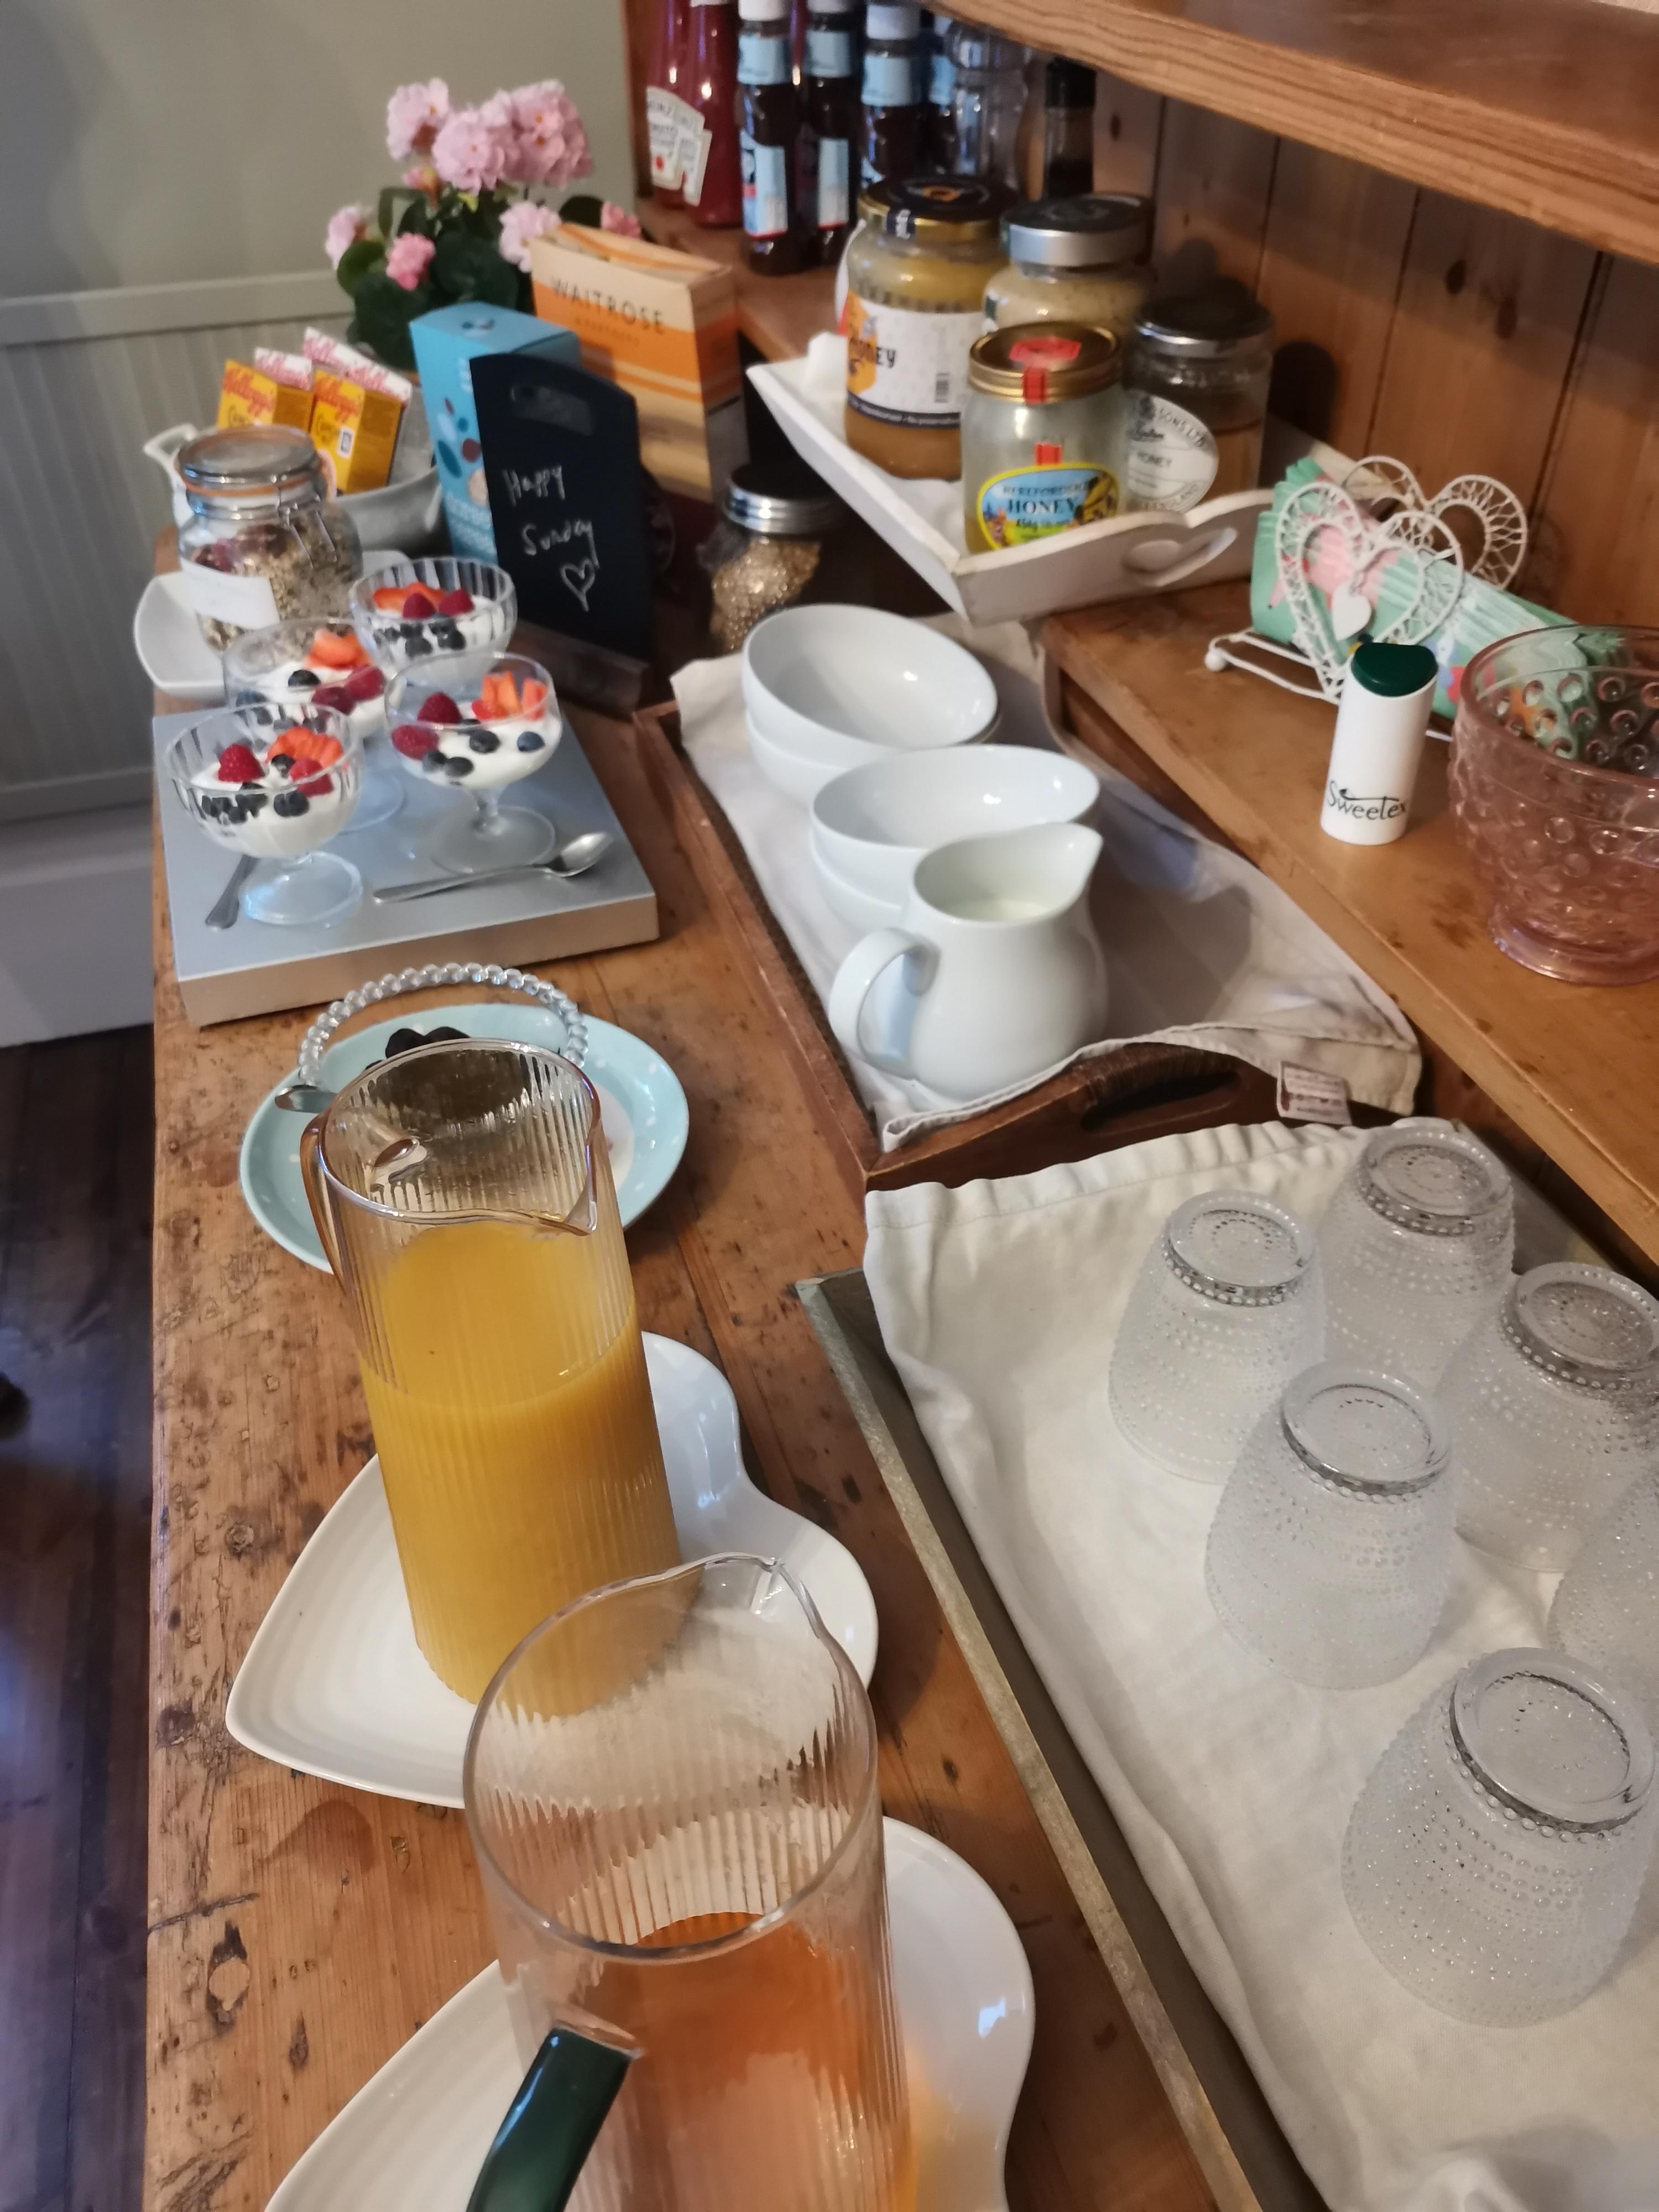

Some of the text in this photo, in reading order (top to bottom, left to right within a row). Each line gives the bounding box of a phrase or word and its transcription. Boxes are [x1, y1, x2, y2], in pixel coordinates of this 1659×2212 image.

[550, 275, 666, 335] WAITROSE
[502, 463, 566, 507] Happy
[1007, 498, 1078, 514] HONEY
[520, 519, 600, 568] Sunday
